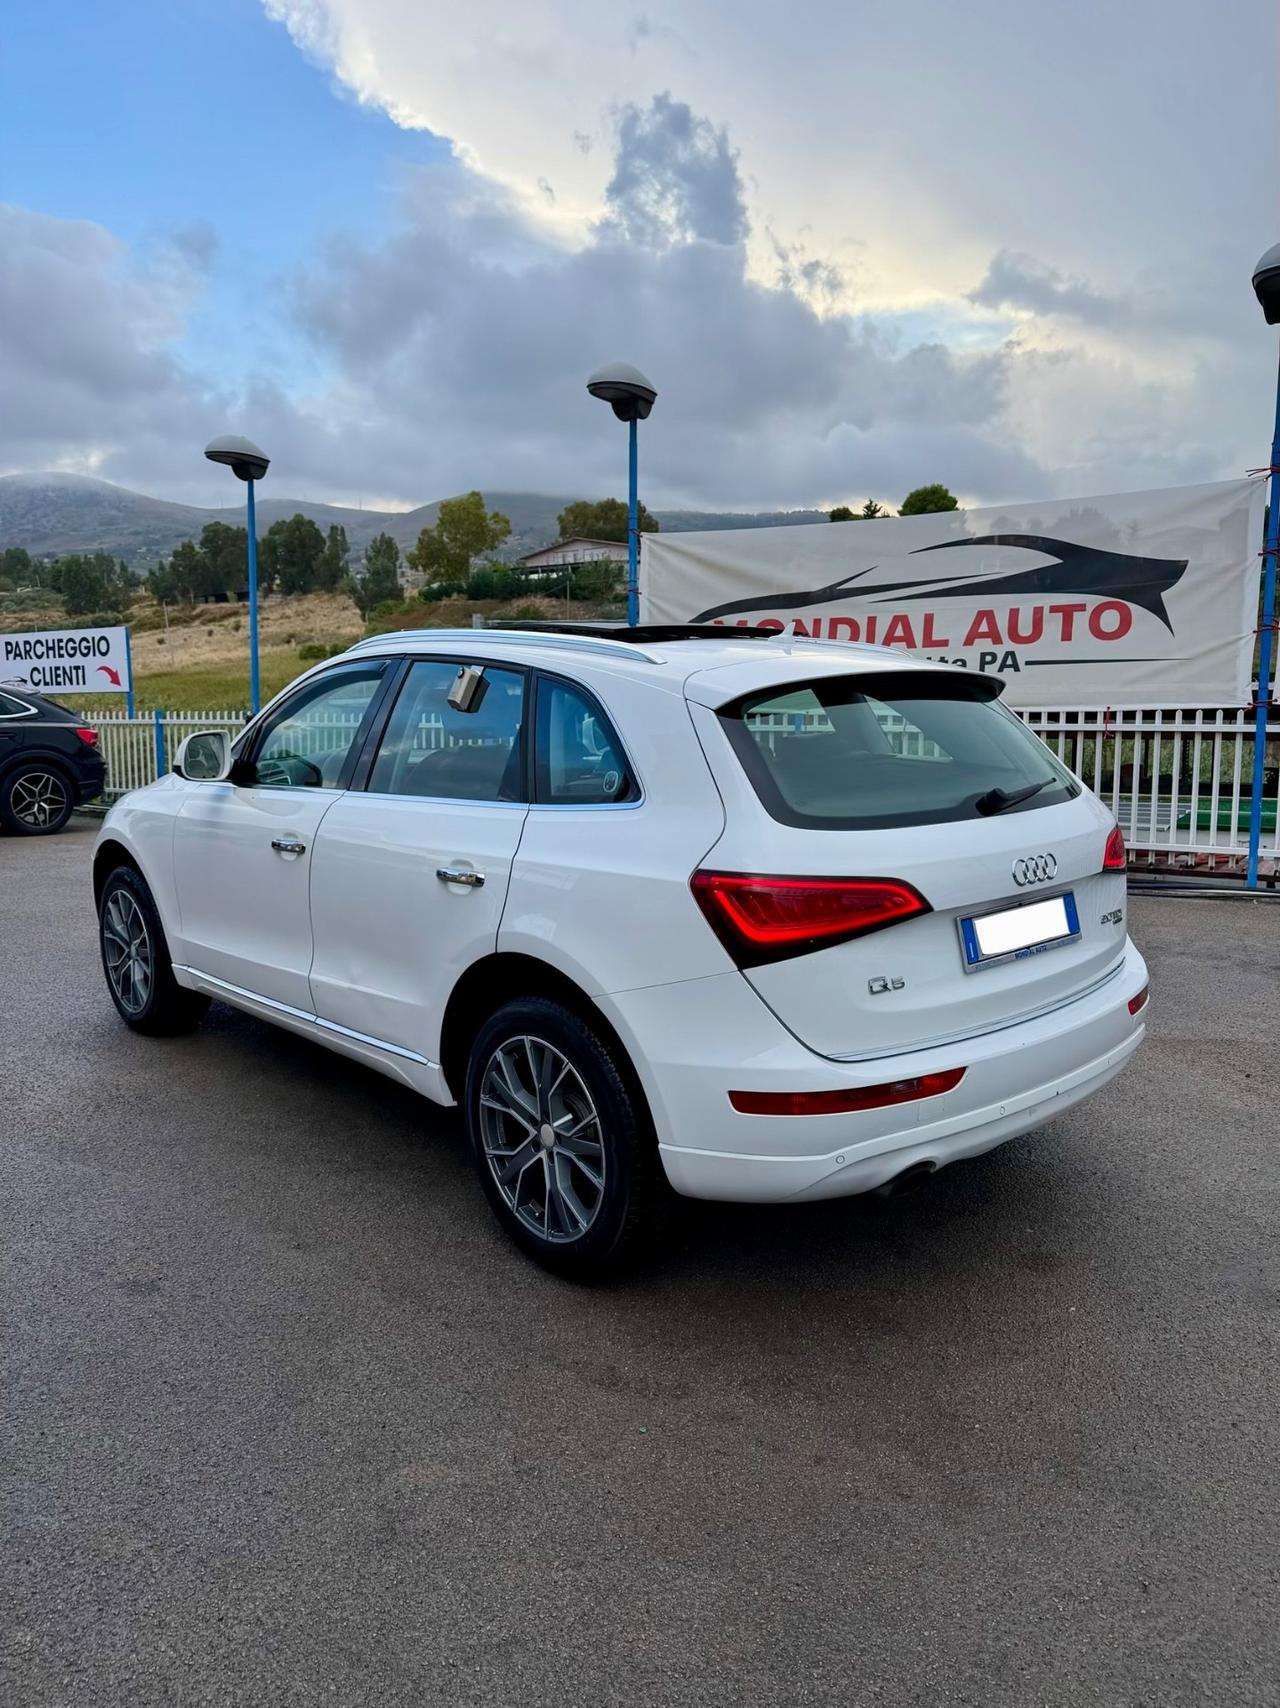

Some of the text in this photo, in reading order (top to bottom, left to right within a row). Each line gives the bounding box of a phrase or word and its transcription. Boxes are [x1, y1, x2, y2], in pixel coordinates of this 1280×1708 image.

[962, 600, 1133, 647] AUTO
[4, 635, 111, 661] PARCHEGGIO
[978, 650, 1021, 673] PA
[29, 665, 87, 687] CLIENTI
[867, 975, 906, 995] Q5
